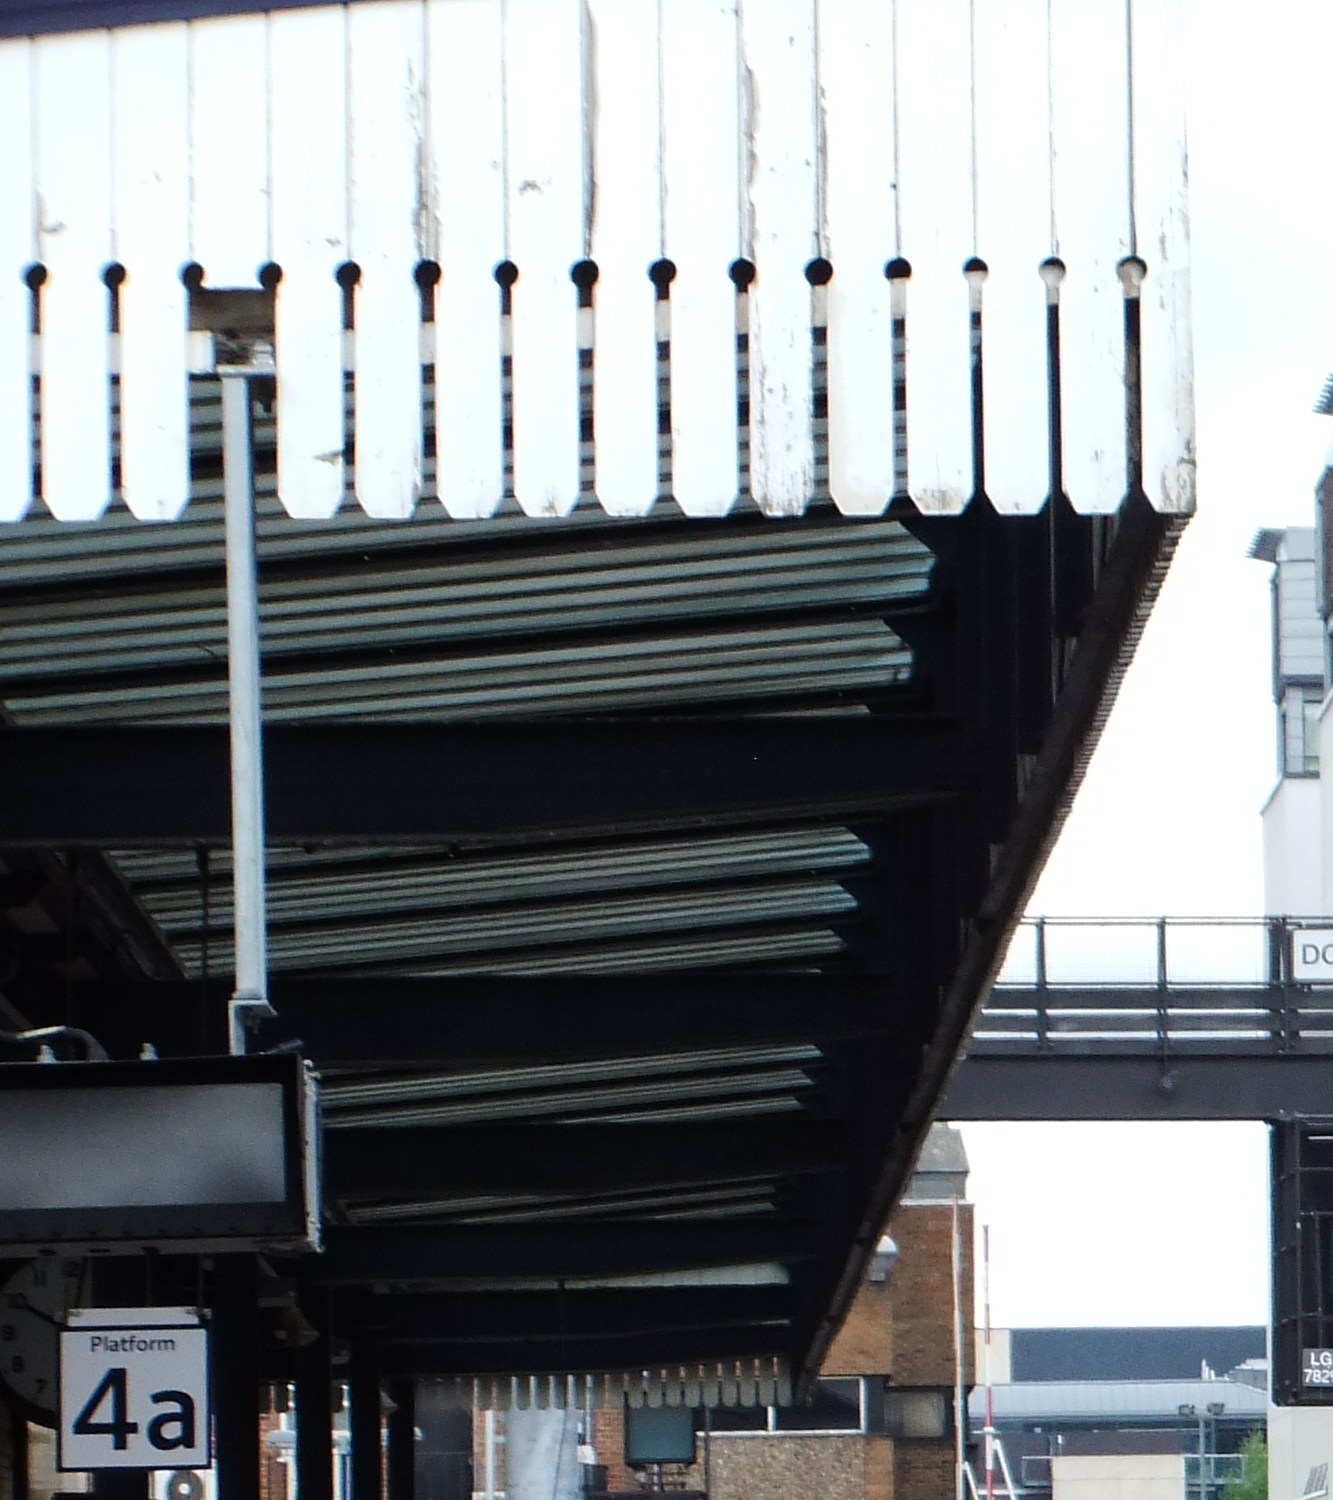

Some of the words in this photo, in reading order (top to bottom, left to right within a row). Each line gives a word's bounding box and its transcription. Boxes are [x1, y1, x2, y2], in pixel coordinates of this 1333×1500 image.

[90, 1335, 176, 1353] Platform
[1310, 1352, 1333, 1366] LG
[72, 1367, 196, 1451] 4a
